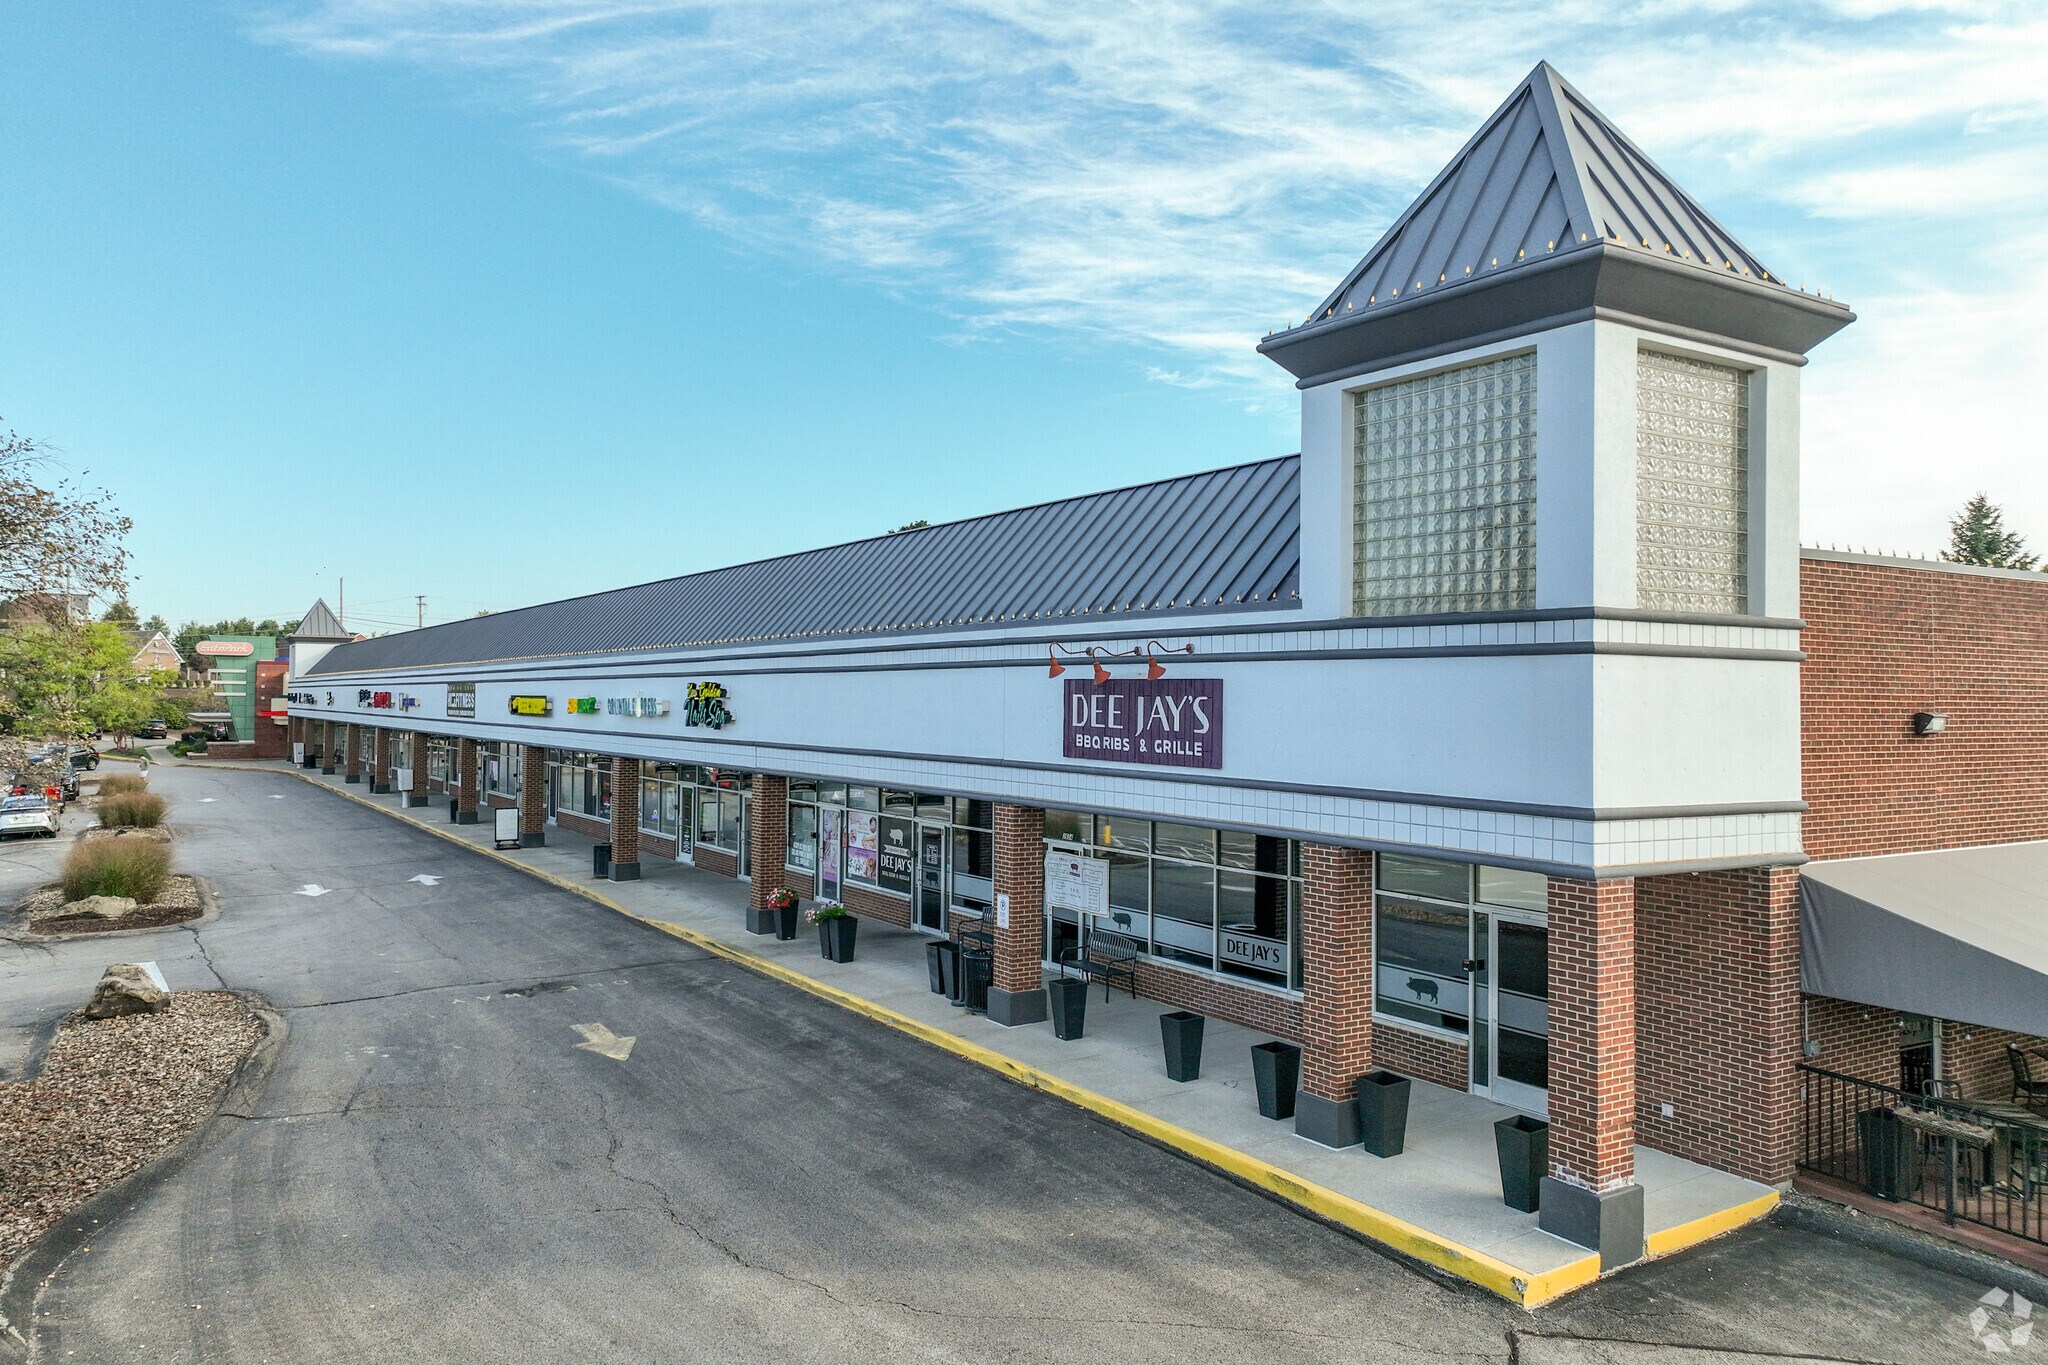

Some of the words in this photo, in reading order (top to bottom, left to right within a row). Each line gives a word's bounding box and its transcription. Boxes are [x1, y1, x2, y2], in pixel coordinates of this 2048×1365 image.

[632, 697, 657, 717] EPRESS
[1072, 694, 1124, 729] DEE
[1135, 695, 1210, 737] JAY'S
[1075, 733, 1101, 750] BBQ
[1102, 735, 1130, 752] RIBS
[1139, 738, 1148, 753] &
[1154, 739, 1203, 757] GRILLE
[880, 854, 894, 869] DEE
[894, 856, 912, 873] JAY'S
[1226, 938, 1249, 957] DEE
[1250, 943, 1280, 964] JAY'S
